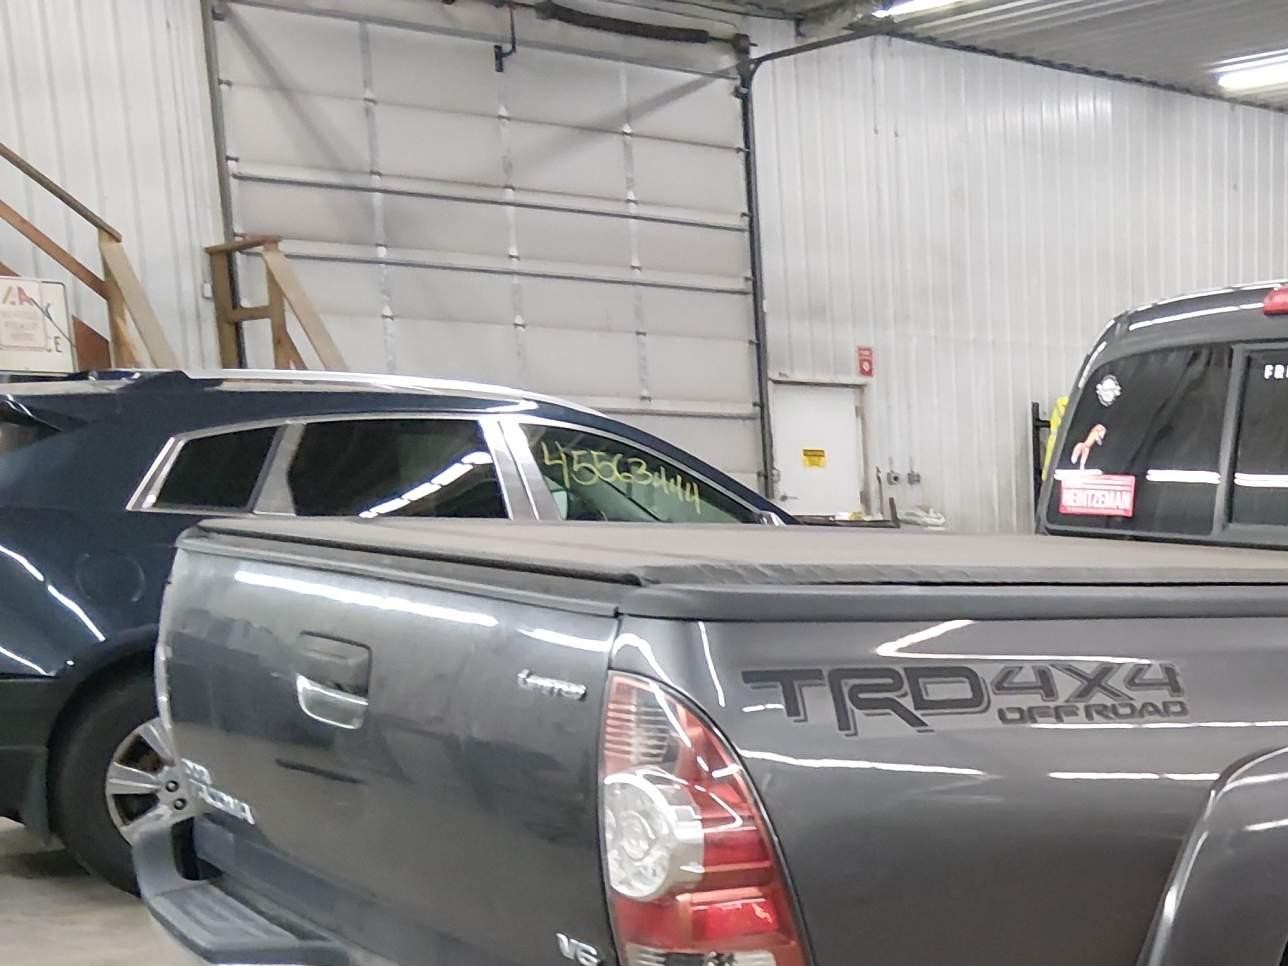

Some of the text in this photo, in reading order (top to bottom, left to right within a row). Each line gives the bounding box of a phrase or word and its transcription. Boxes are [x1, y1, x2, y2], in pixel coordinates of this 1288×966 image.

[742, 666, 990, 737] TRD
[997, 700, 1191, 725] OFF ROAD
